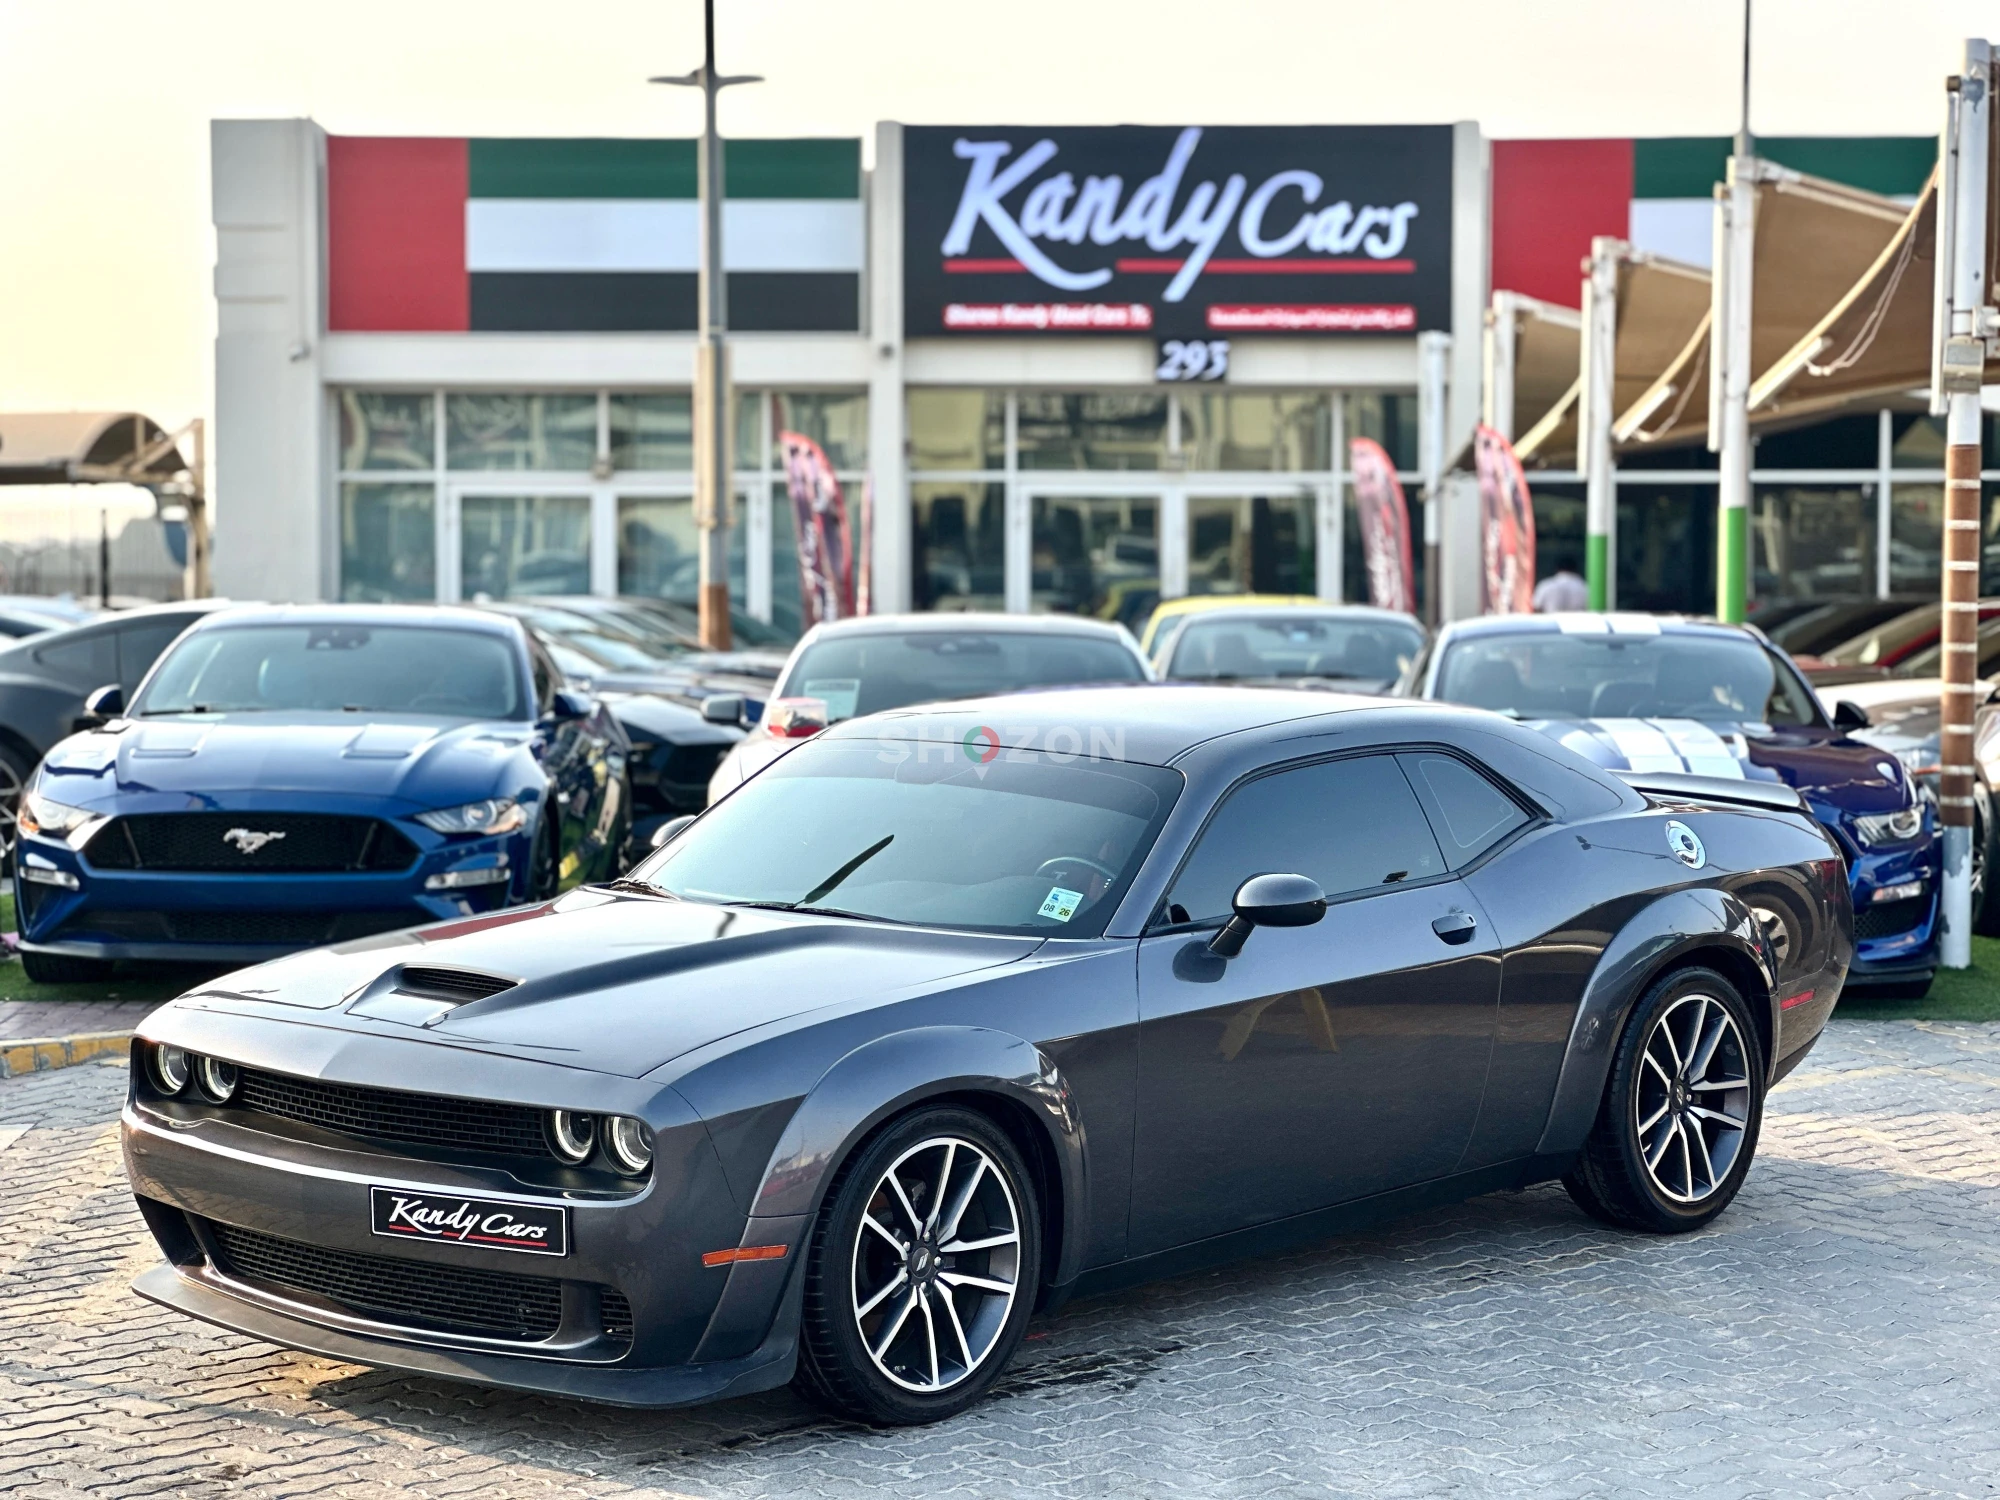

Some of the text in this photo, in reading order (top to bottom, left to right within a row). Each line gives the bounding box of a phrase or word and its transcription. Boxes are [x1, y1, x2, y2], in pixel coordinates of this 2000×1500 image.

[941, 126, 1419, 302] Kandy Cars
[1043, 903, 1071, 917] 08 26
[388, 1196, 548, 1241] Kandy Cars
